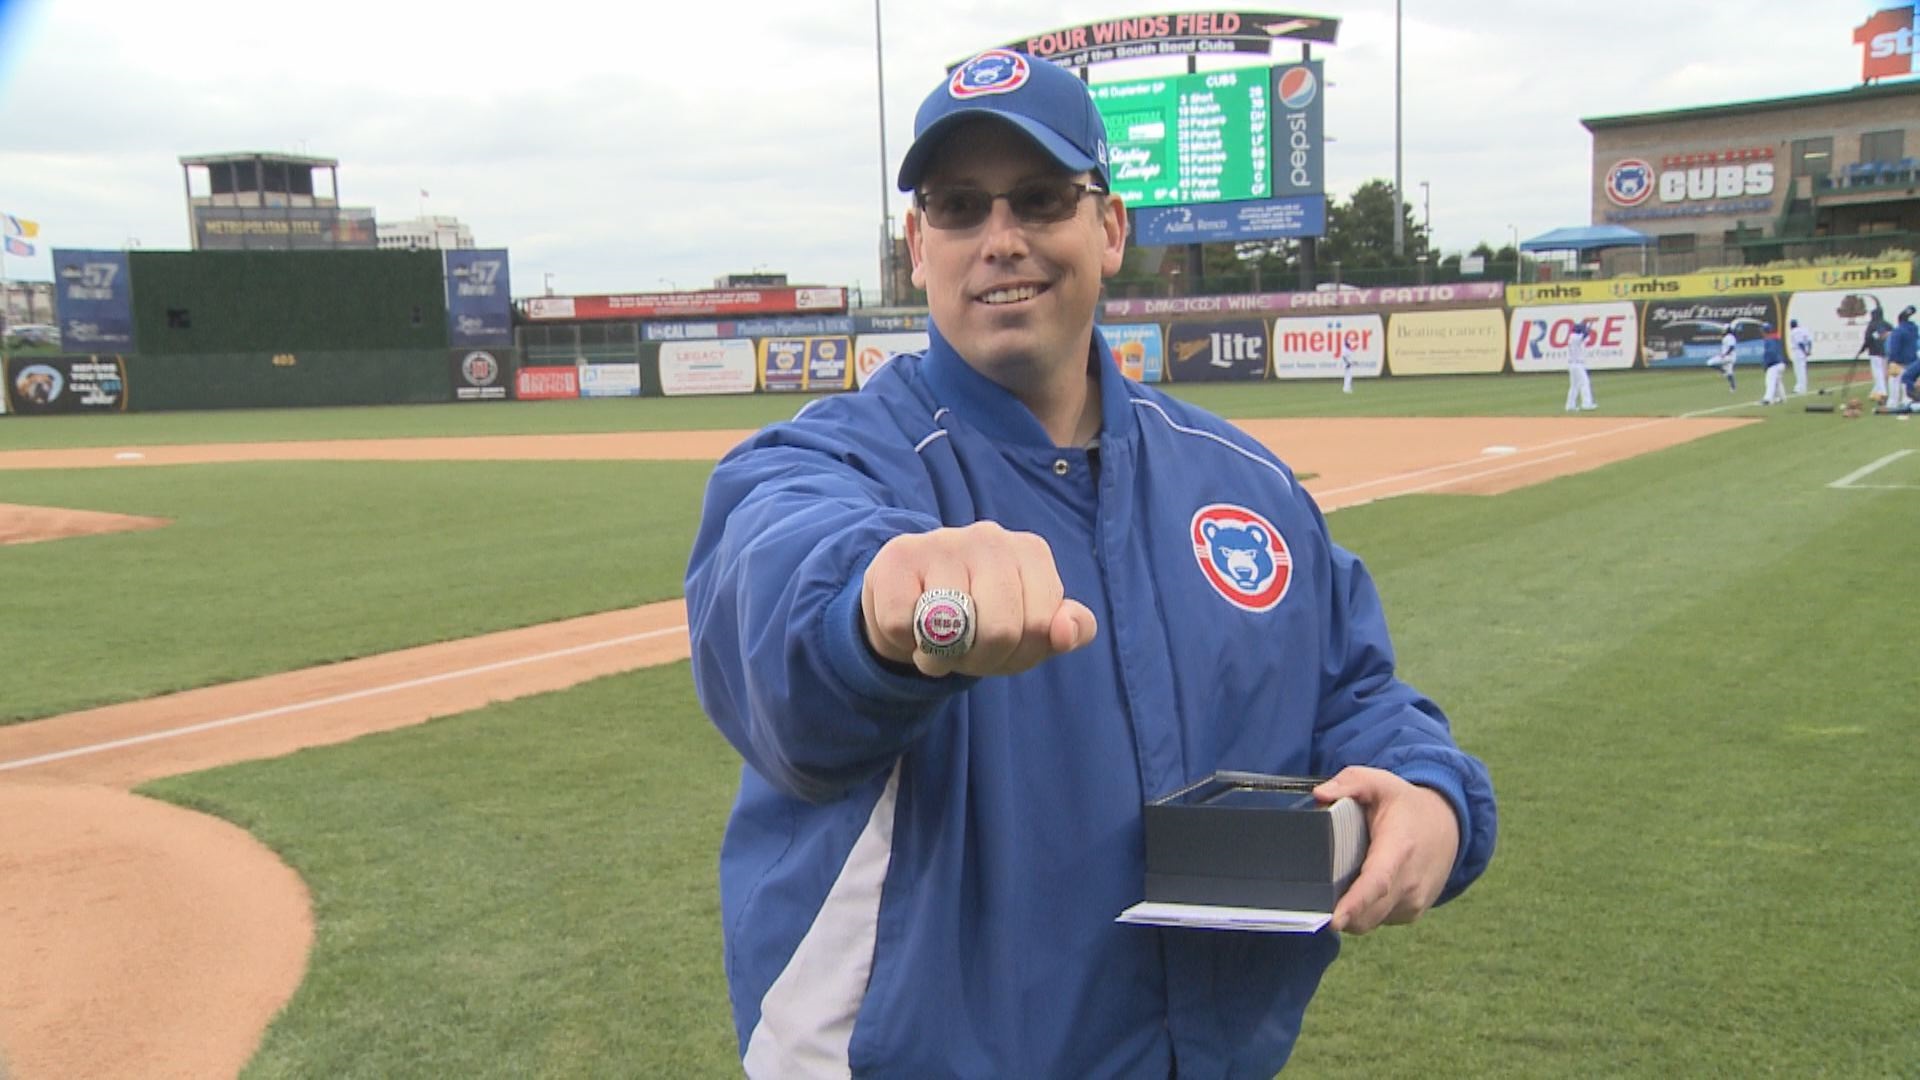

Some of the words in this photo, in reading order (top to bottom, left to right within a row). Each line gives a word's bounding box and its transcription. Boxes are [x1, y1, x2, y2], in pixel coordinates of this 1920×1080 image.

[1027, 27, 1087, 57] FOUR
[1092, 15, 1169, 44] WINDS
[1176, 12, 1240, 36] FIELD
[1074, 53, 1089, 65] of
[1091, 49, 1114, 61] the
[1116, 45, 1157, 57] South
[1159, 42, 1196, 53] Bend
[1198, 39, 1236, 51] Cubs
[1206, 73, 1237, 87] CUBS
[1287, 113, 1311, 186] pepsi
[1659, 163, 1775, 203] CUBS
[205, 220, 289, 235] METROPOLITAN
[291, 220, 321, 235] TITLE
[82, 262, 119, 287] 57
[471, 260, 501, 285] 57
[1733, 273, 1784, 288] mhs
[1842, 266, 1897, 281] mhs
[1290, 288, 1371, 308] PARTY
[1379, 285, 1455, 303] PATIO
[1537, 284, 1582, 299] mhs
[1631, 279, 1680, 293] mhs
[1652, 304, 1697, 321] Royal
[1696, 302, 1769, 319] Excursion
[1283, 322, 1372, 359] meijer
[1515, 315, 1626, 360] ROSE
[676, 350, 728, 361] LEGACY
[1209, 332, 1263, 368] Lite
